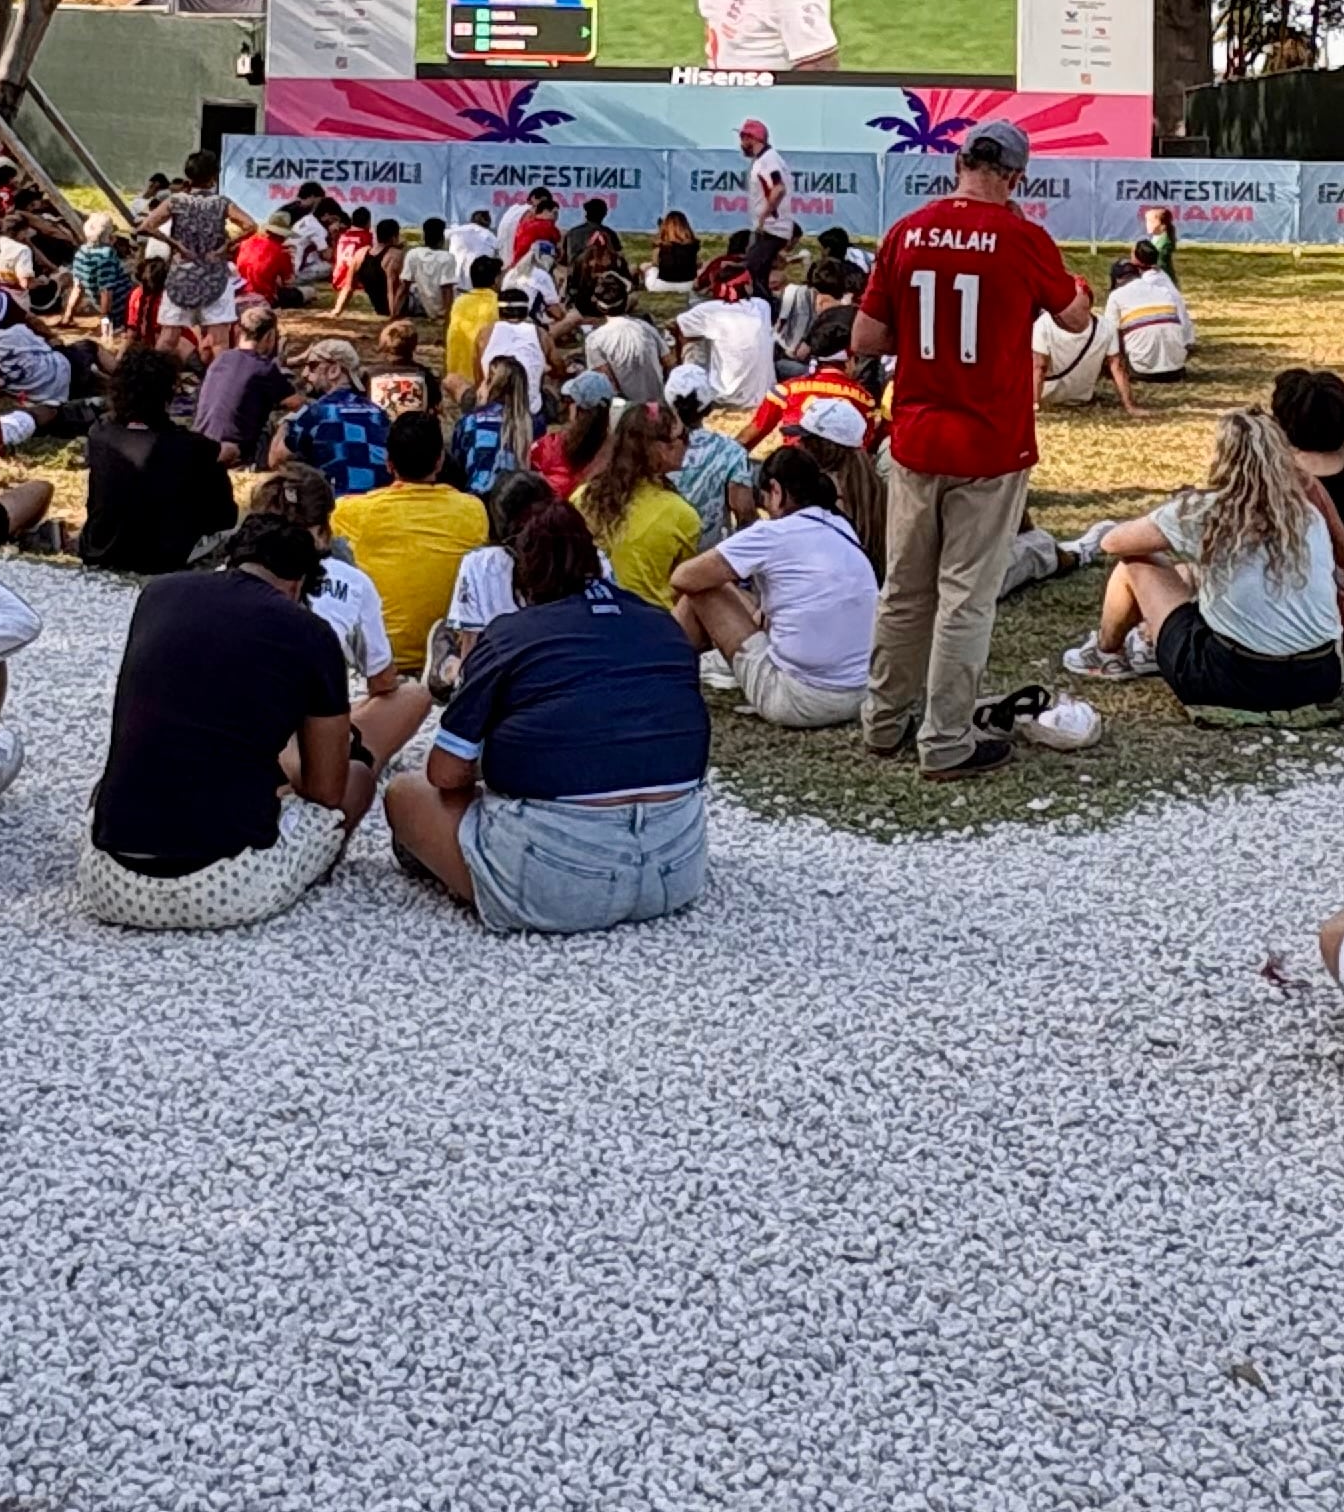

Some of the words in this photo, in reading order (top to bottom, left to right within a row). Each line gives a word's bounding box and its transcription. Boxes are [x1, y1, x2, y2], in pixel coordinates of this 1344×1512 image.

[670, 65, 777, 87] Hisense
[268, 183, 398, 205] MAMI
[713, 195, 835, 214] MMI
[910, 270, 980, 364] 11
